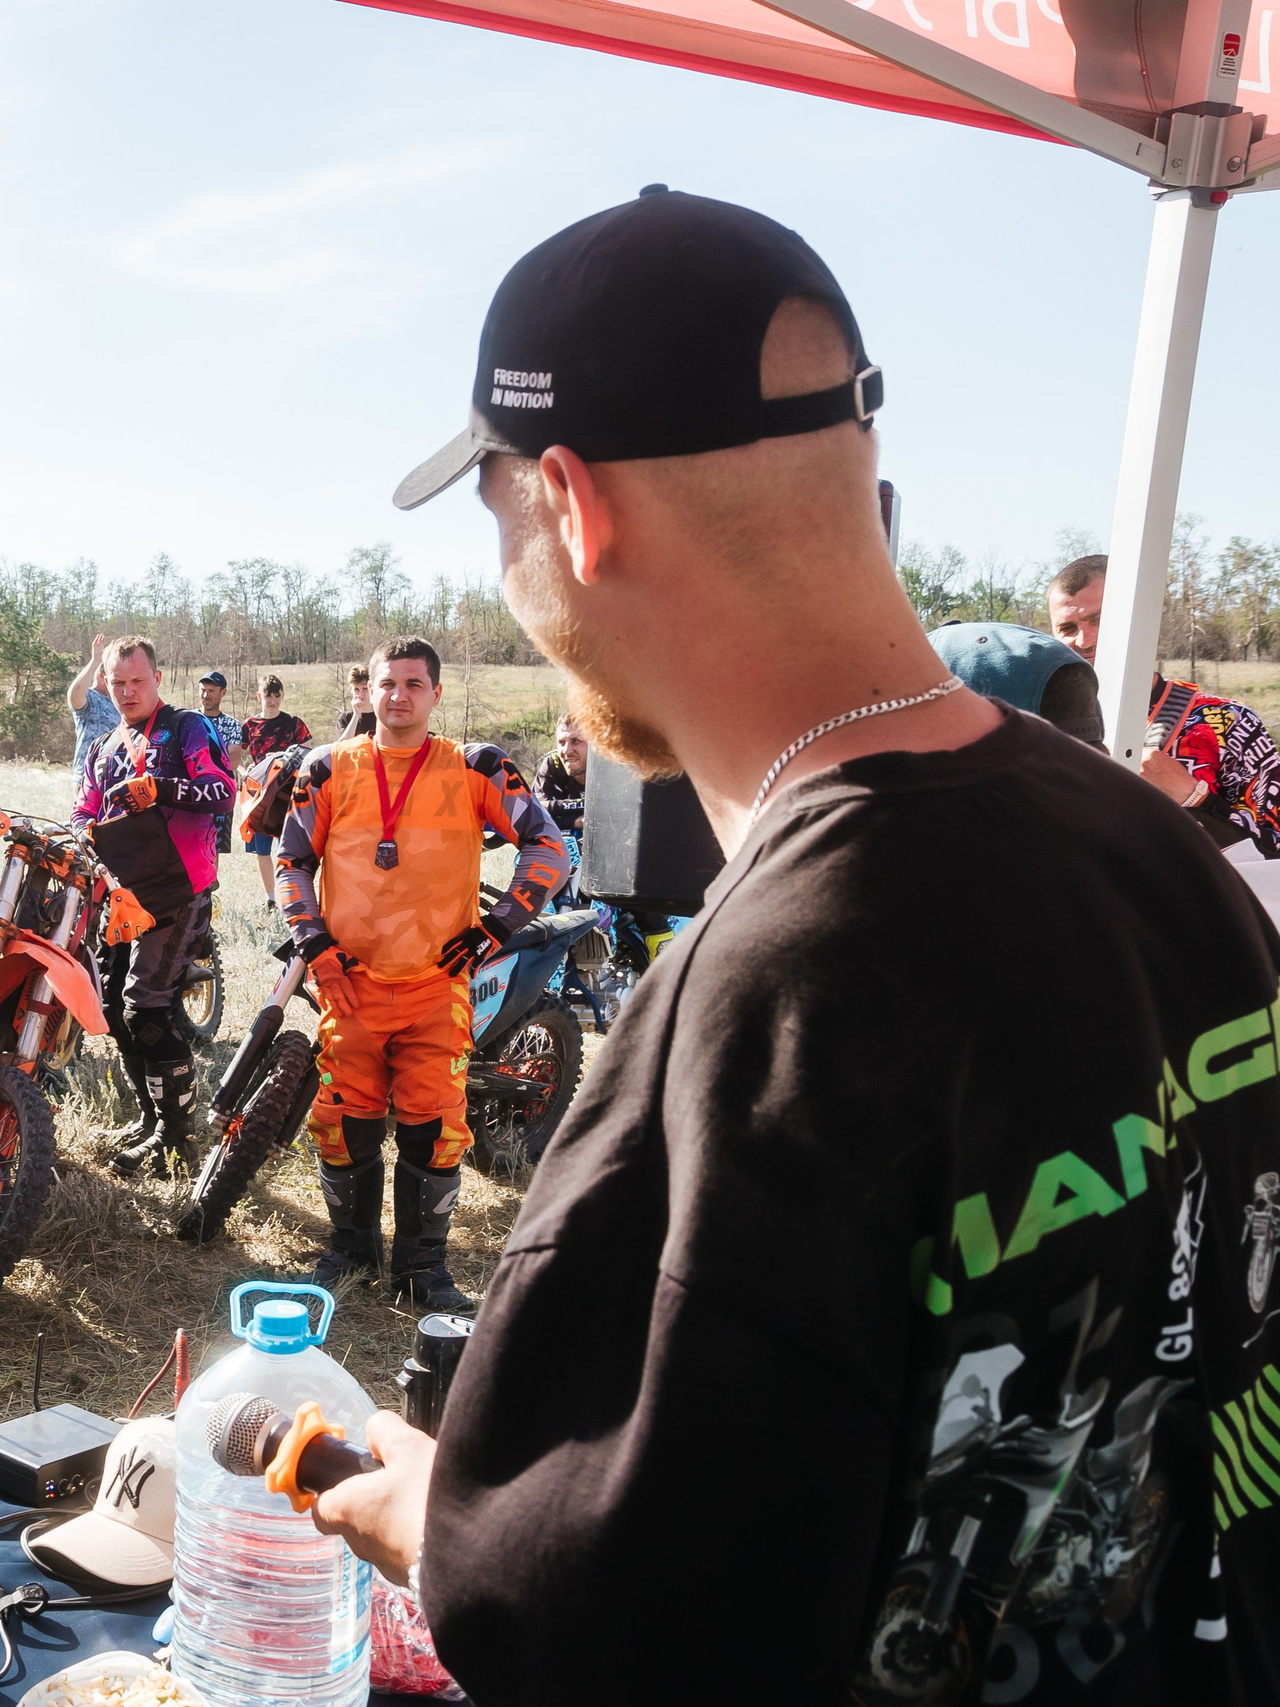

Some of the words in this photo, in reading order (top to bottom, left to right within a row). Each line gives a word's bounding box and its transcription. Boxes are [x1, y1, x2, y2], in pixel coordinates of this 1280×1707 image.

[493, 368, 553, 389] FREEDOM
[490, 388, 503, 407] IN
[502, 389, 554, 409] MOTION
[177, 781, 230, 802] FXR
[1155, 1307, 1194, 1362] GL
